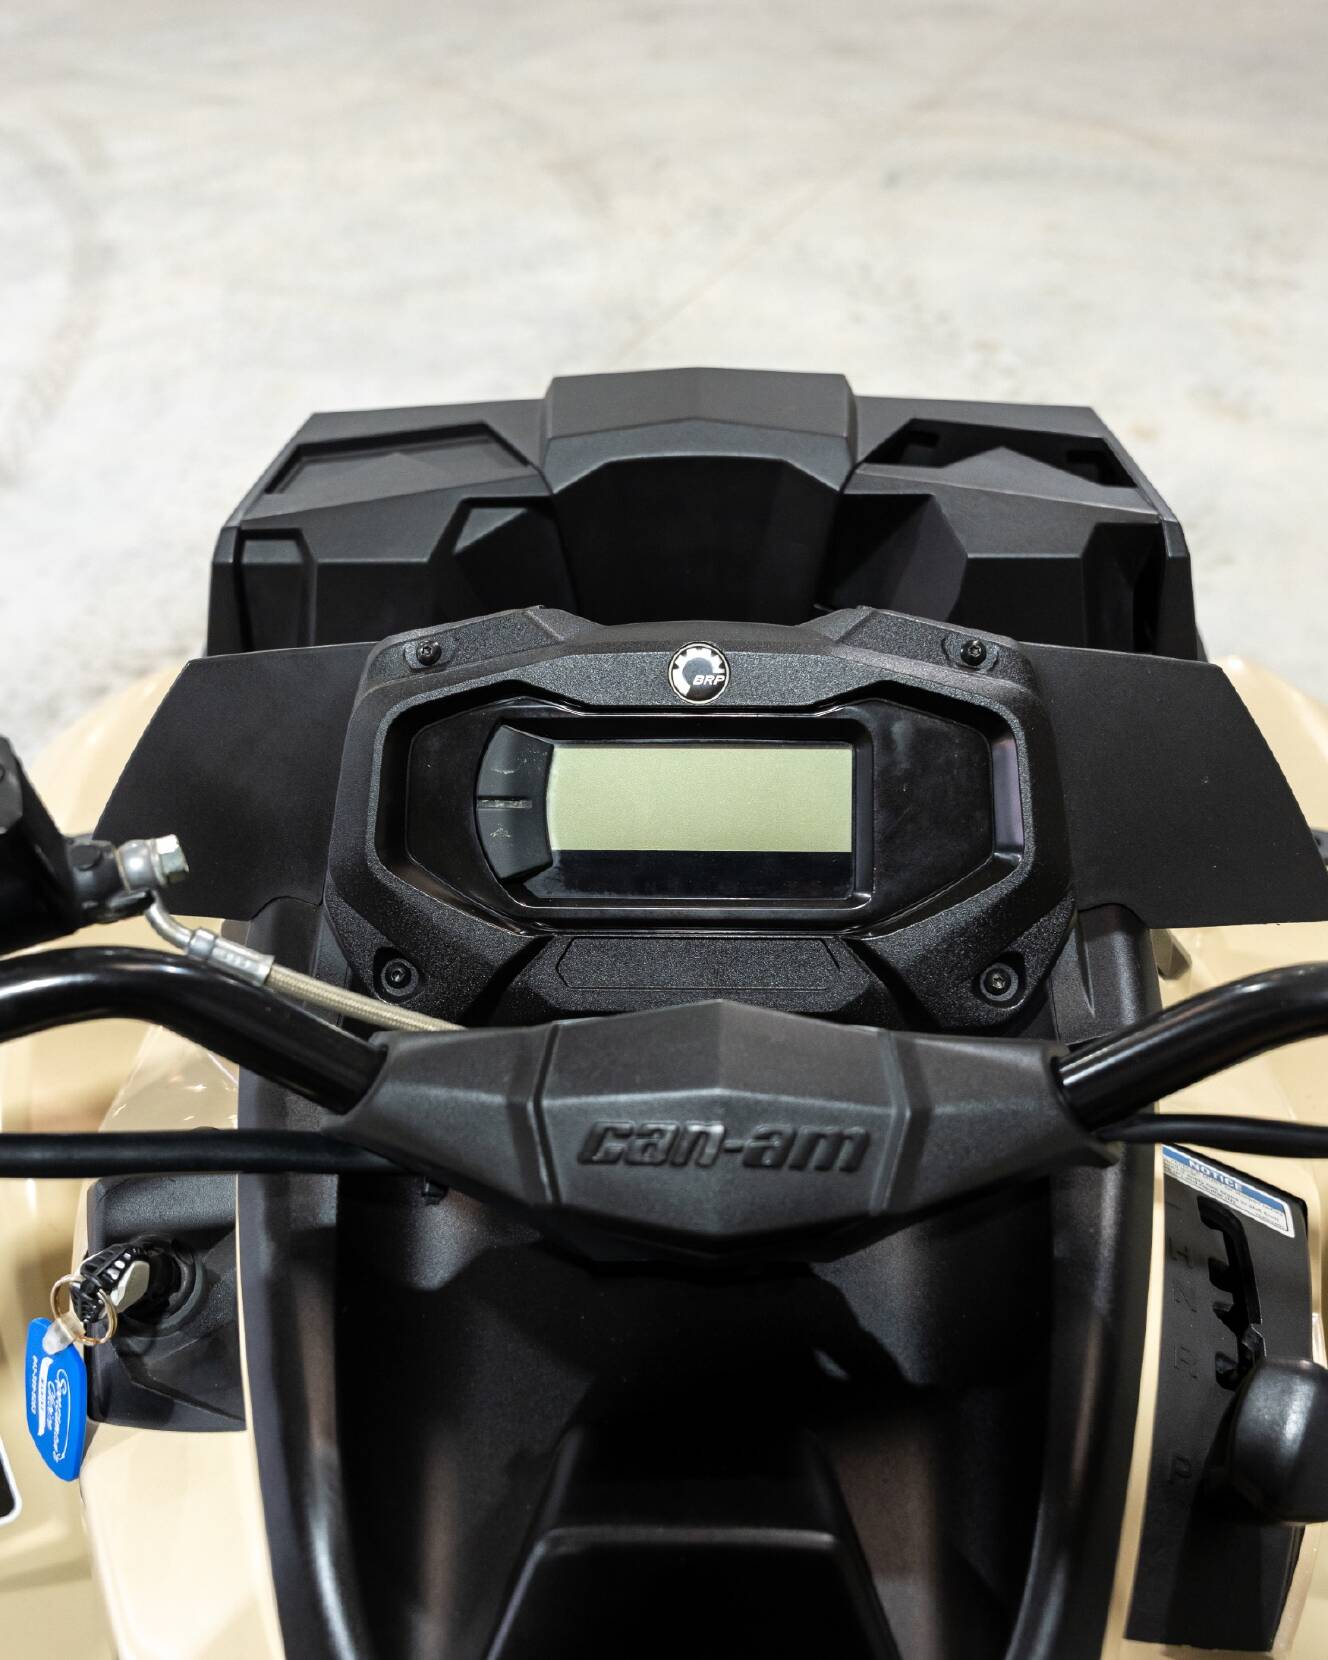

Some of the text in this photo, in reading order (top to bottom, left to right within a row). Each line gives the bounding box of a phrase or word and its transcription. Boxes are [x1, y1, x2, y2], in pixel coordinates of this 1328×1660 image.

[692, 674, 725, 686] BRP
[577, 1120, 870, 1173] can-am
[1188, 1159, 1243, 1192] NOTICE
